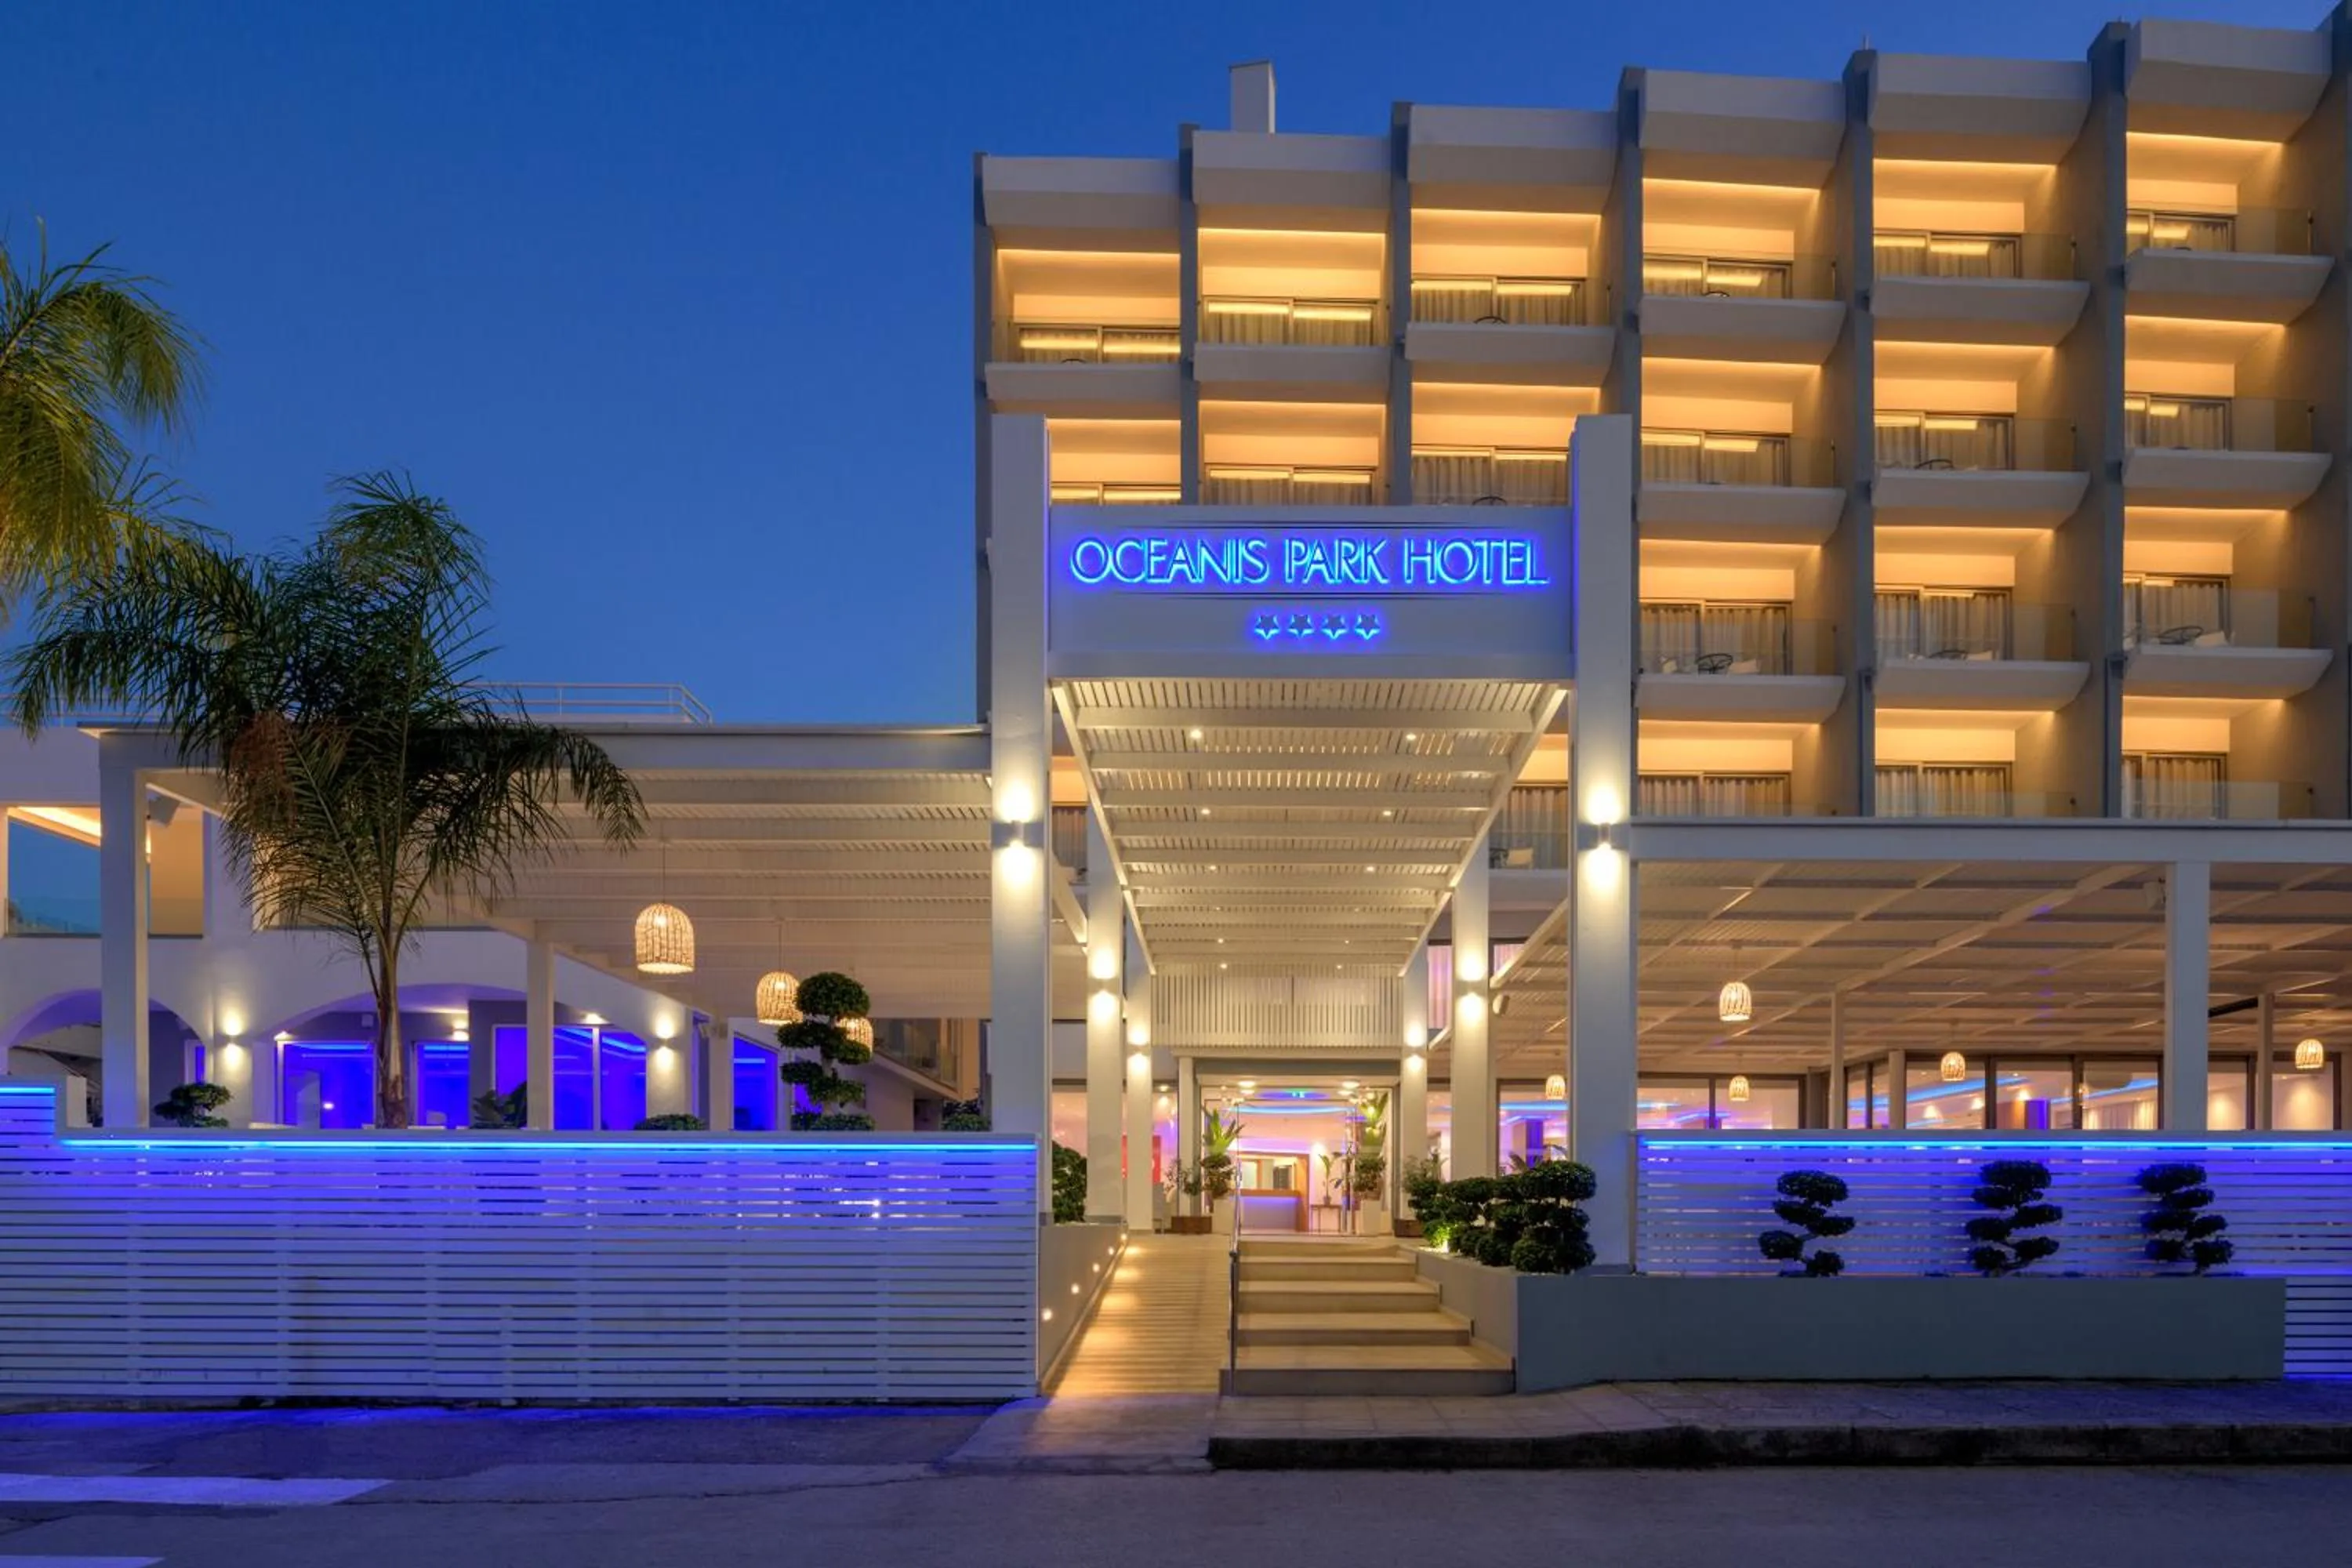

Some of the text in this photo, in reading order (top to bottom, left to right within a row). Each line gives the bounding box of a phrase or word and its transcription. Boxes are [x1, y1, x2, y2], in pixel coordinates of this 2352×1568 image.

[1071, 536, 1548, 585] OCEANIS PARK HOTEL
